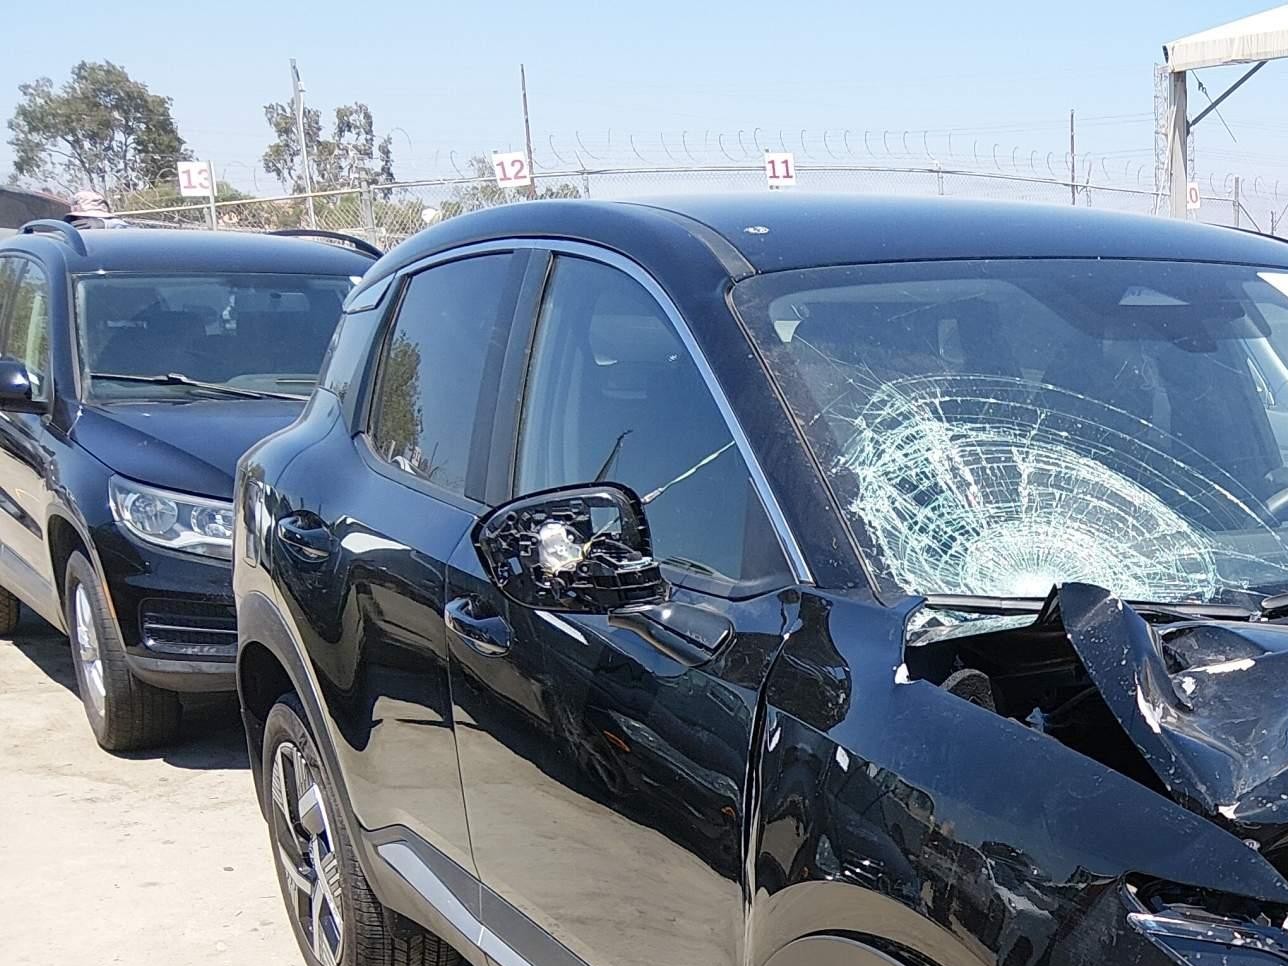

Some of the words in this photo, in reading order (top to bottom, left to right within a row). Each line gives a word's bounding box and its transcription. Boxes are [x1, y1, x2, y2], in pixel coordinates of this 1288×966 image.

[181, 169, 209, 189] 13
[495, 159, 527, 181] 12
[767, 159, 793, 179] 11
[1187, 187, 1199, 204] 0
